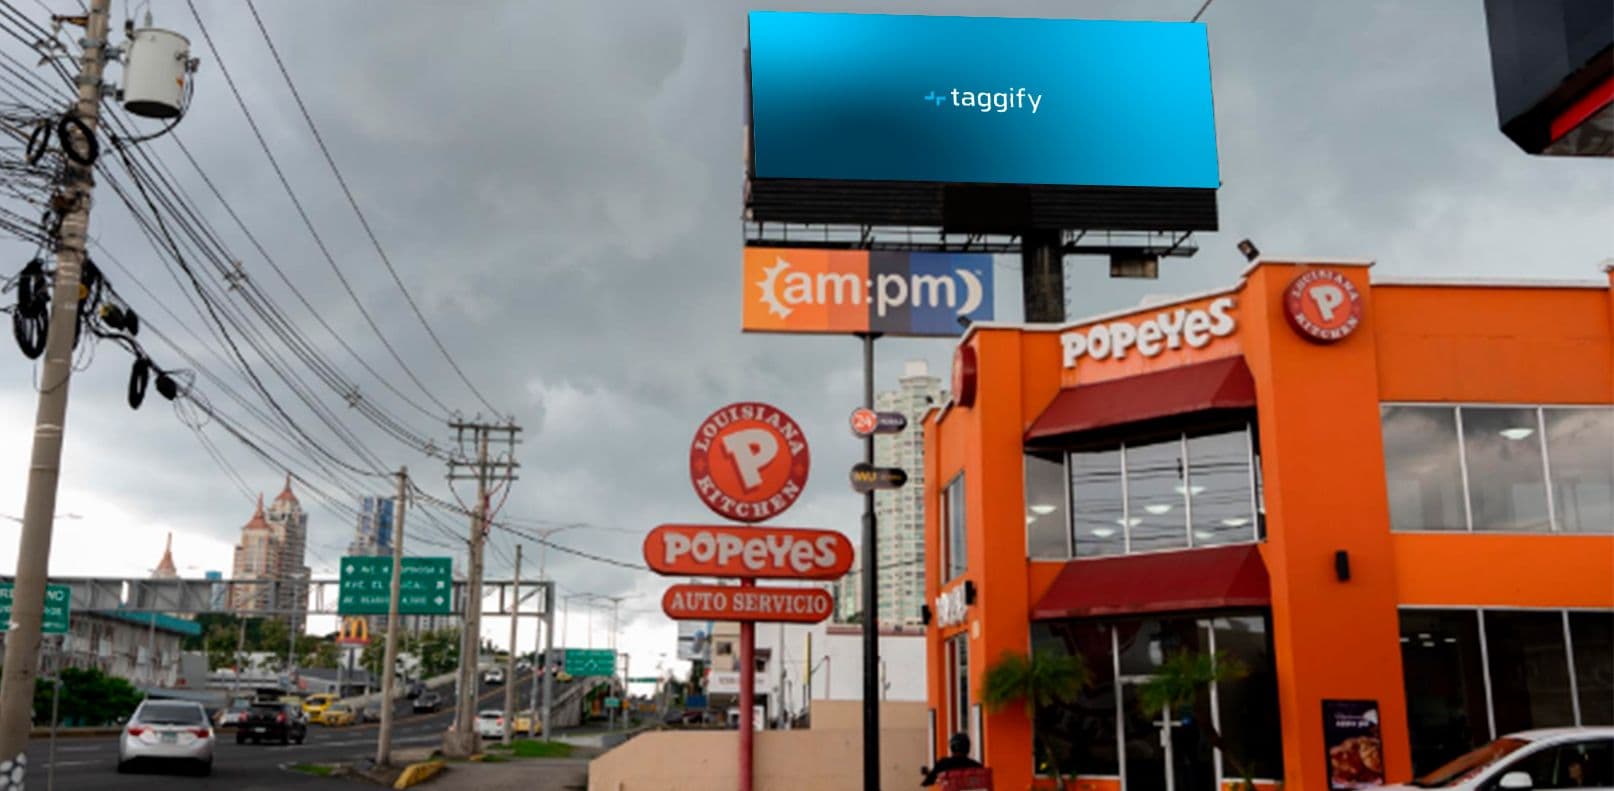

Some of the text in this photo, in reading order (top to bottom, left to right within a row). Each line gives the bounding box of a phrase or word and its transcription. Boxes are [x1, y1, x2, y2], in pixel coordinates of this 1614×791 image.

[950, 87, 1042, 114] taggify
[1309, 284, 1345, 322] P
[695, 406, 804, 455] LOUISIANA
[722, 429, 778, 489] P
[697, 475, 799, 517] KITCHEN
[671, 592, 827, 614] AUTO SERVICIO
